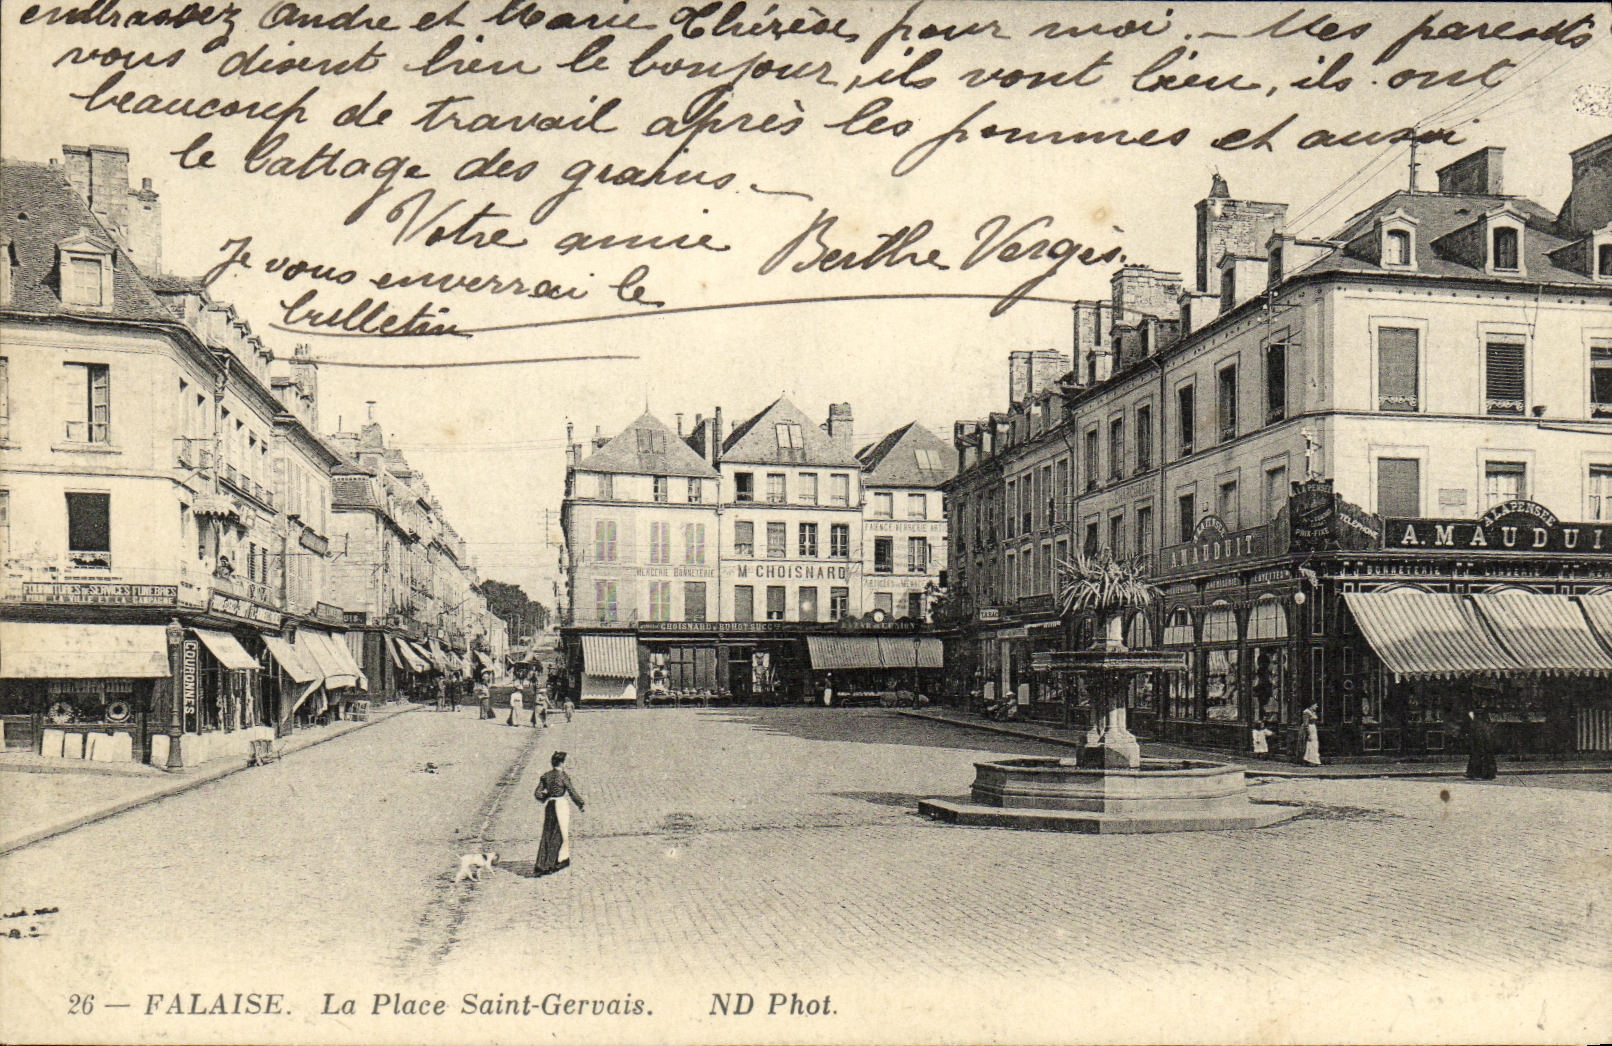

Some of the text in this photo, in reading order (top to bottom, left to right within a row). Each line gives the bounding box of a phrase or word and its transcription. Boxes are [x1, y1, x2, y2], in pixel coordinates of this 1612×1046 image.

[52, 46, 186, 69] vous
[216, 41, 380, 78] disent
[404, 34, 543, 77] bien
[557, 34, 610, 73] le
[860, 47, 939, 90] ils
[961, 50, 1115, 92] vont
[1290, 53, 1360, 92] ils
[1386, 58, 1516, 89] ont
[411, 1, 466, 32] et
[482, 1, 658, 31] Marie
[861, 3, 1012, 64] pour
[1239, 8, 1371, 41] Mes
[1375, 14, 1595, 66] parents
[70, 71, 318, 158] beaucoup
[334, 91, 391, 129] de
[411, 96, 620, 134] travail
[642, 85, 805, 152] après
[823, 98, 914, 136] les
[891, 100, 1195, 178] pommes
[1211, 114, 1298, 151] et
[168, 131, 217, 171] le
[243, 132, 430, 225] battage
[453, 147, 540, 181] des
[385, 187, 527, 250] Votre
[554, 209, 732, 254] amie
[757, 207, 951, 276] Berthe
[202, 236, 667, 308] Je vous enverrai le
[280, 288, 474, 339] bulletin
[90, 584, 130, 596] SERVICES
[755, 564, 846, 580] CHOISNARD
[184, 642, 197, 714] COURONNES
